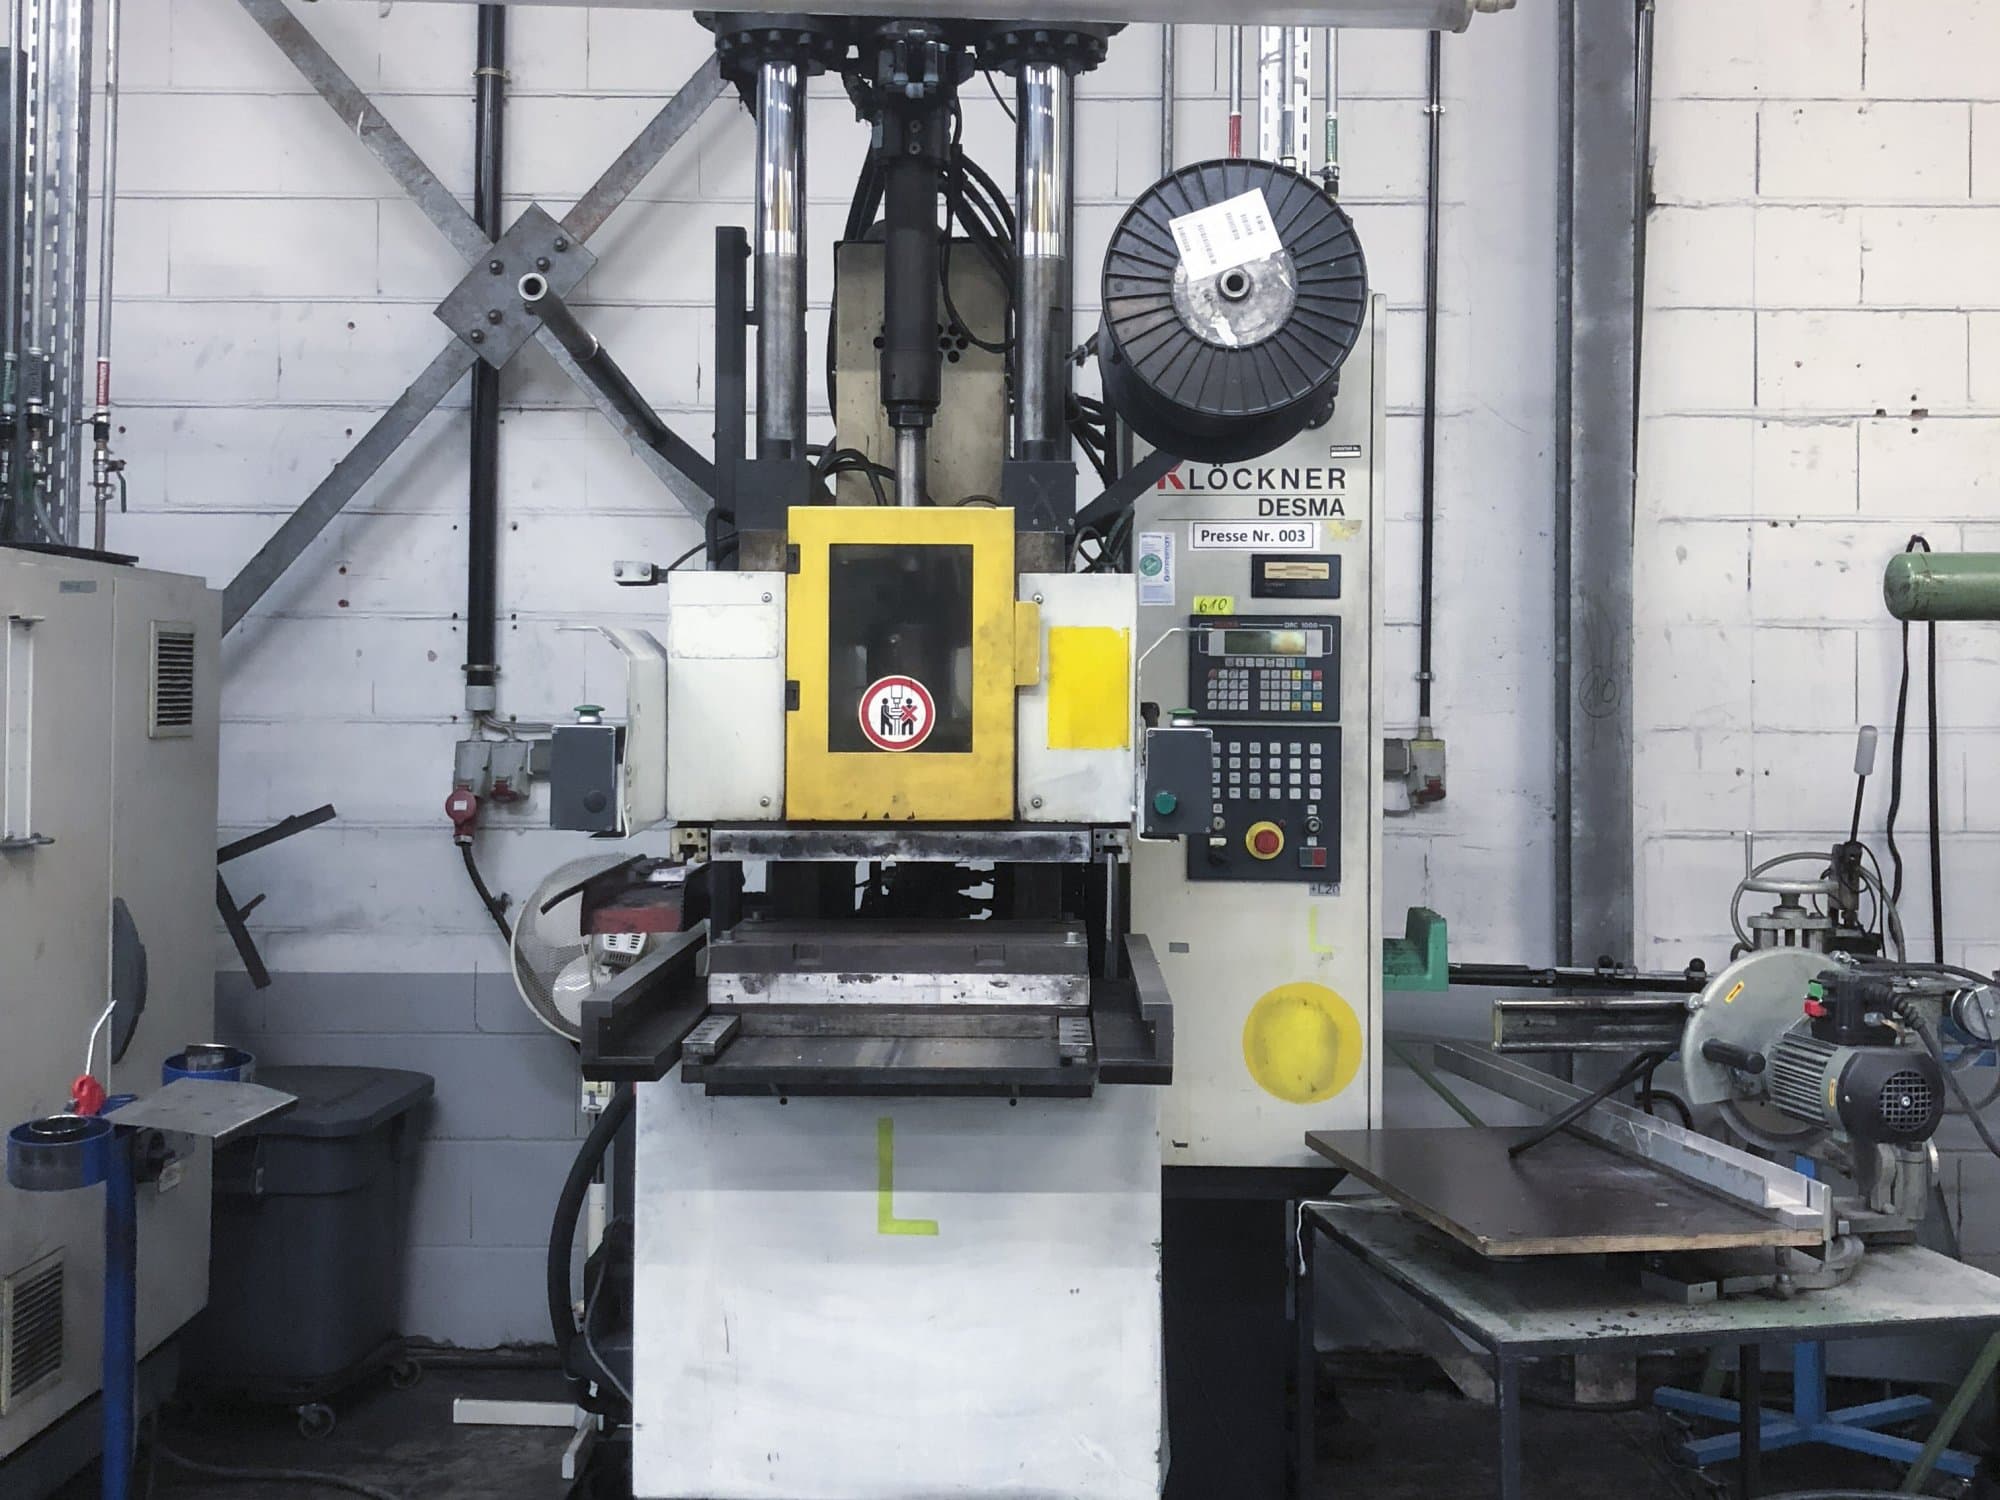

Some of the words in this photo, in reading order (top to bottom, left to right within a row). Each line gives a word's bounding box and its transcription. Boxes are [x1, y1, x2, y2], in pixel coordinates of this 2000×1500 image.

[1157, 461, 1346, 490] KLÖCKNER
[1258, 498, 1345, 516] DESMA
[1201, 530, 1248, 542] Presse
[1252, 530, 1274, 542] Nr.
[1279, 530, 1306, 542] 003
[878, 1116, 940, 1236] L
